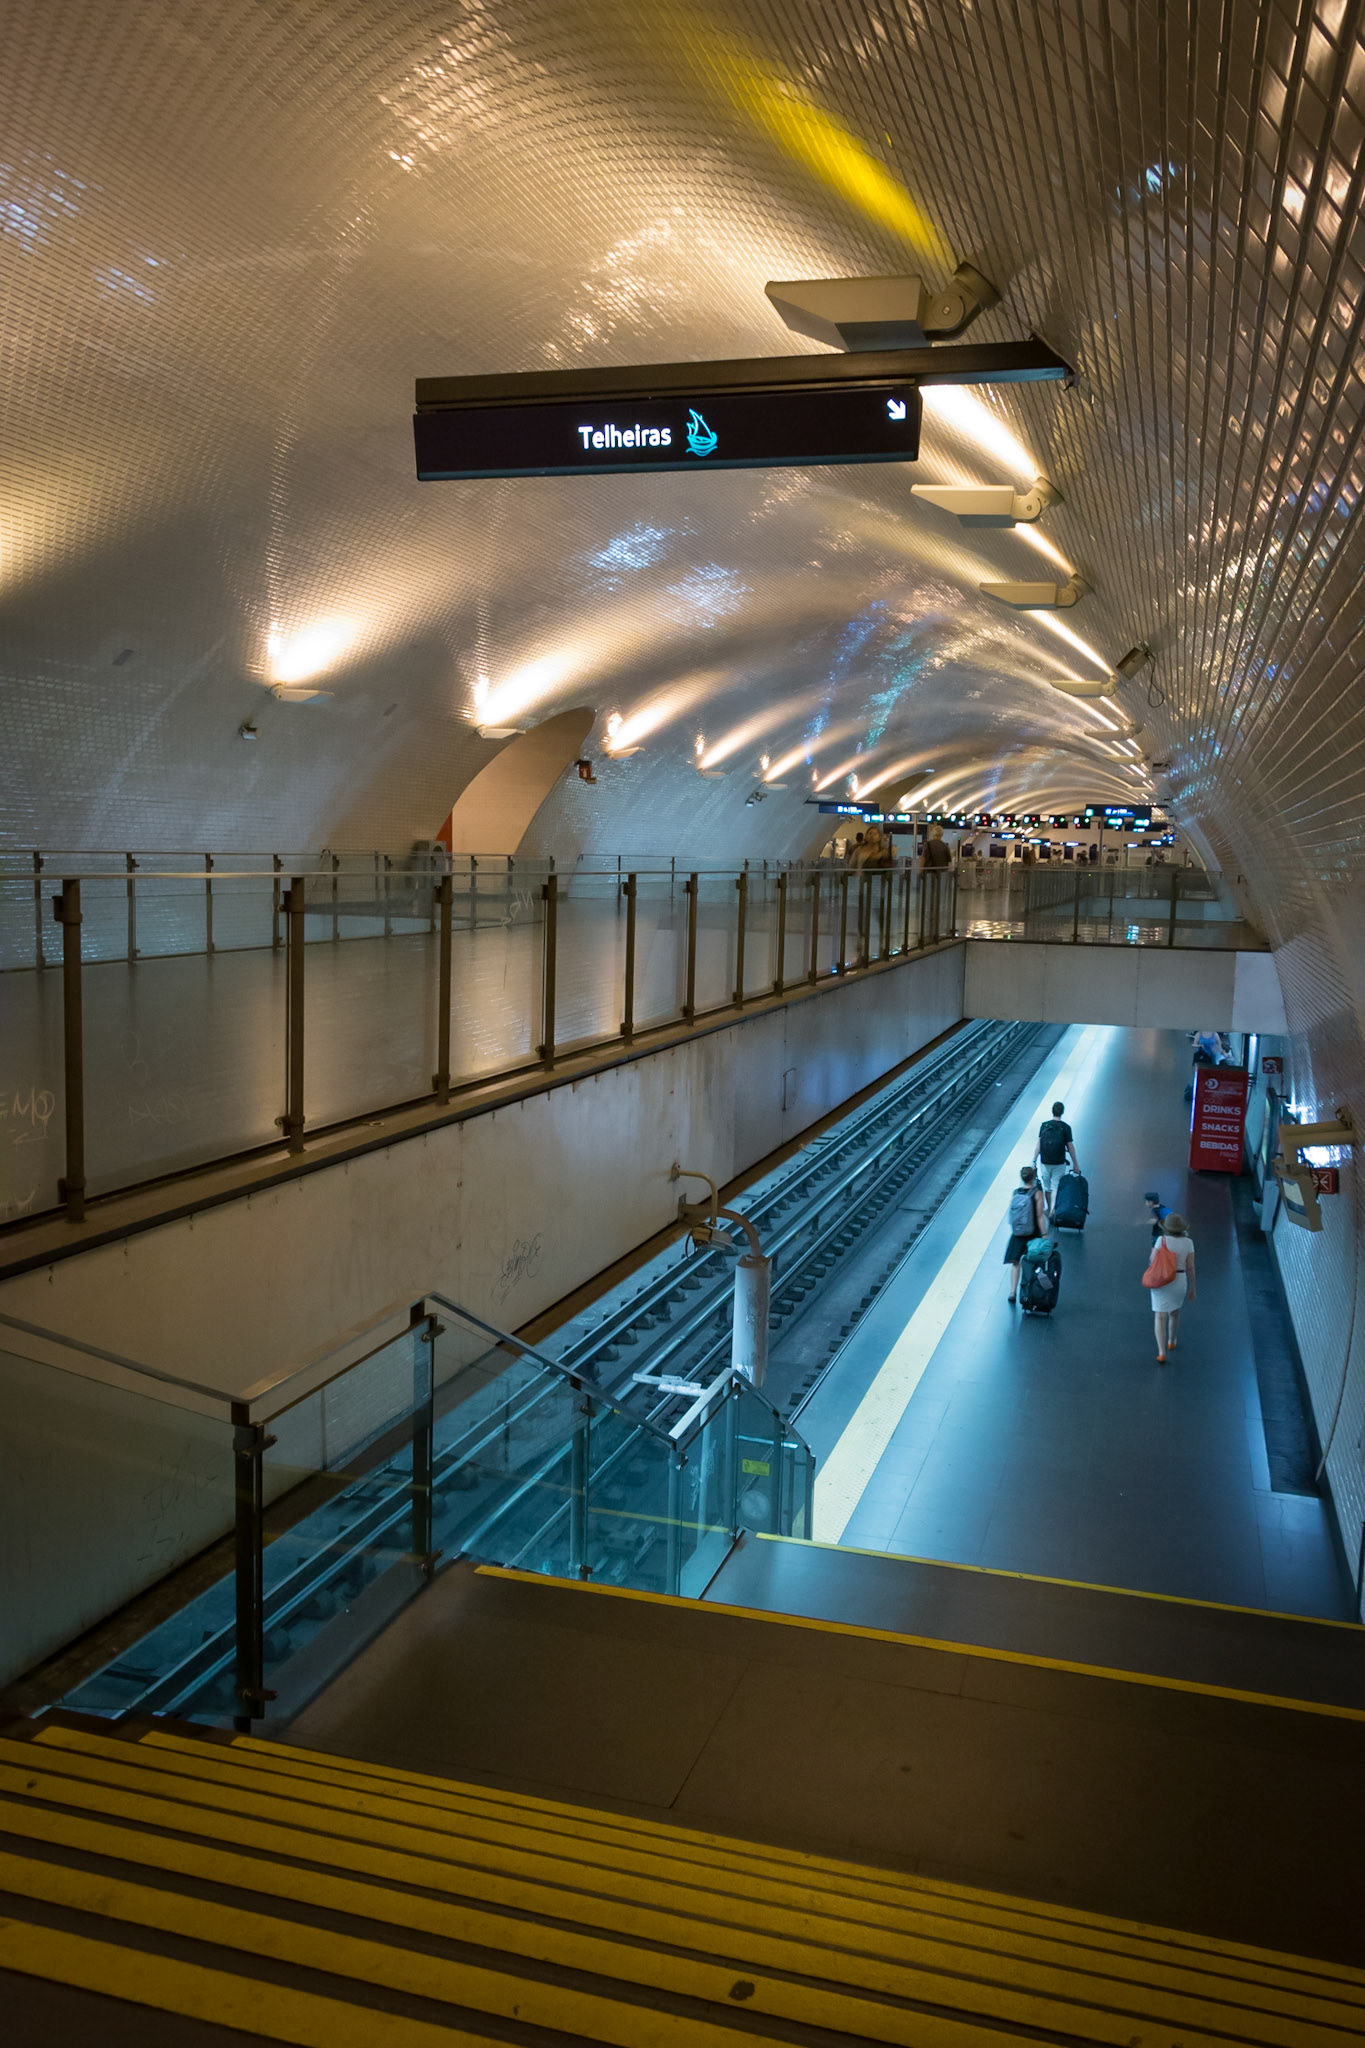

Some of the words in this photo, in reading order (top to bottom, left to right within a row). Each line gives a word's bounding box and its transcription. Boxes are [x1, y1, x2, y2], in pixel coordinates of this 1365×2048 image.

[578, 423, 672, 449] Telheiras
[1202, 1104, 1241, 1116] DRINKS
[1201, 1122, 1240, 1133] SNACKS
[1199, 1140, 1240, 1151] BEBIDAS
